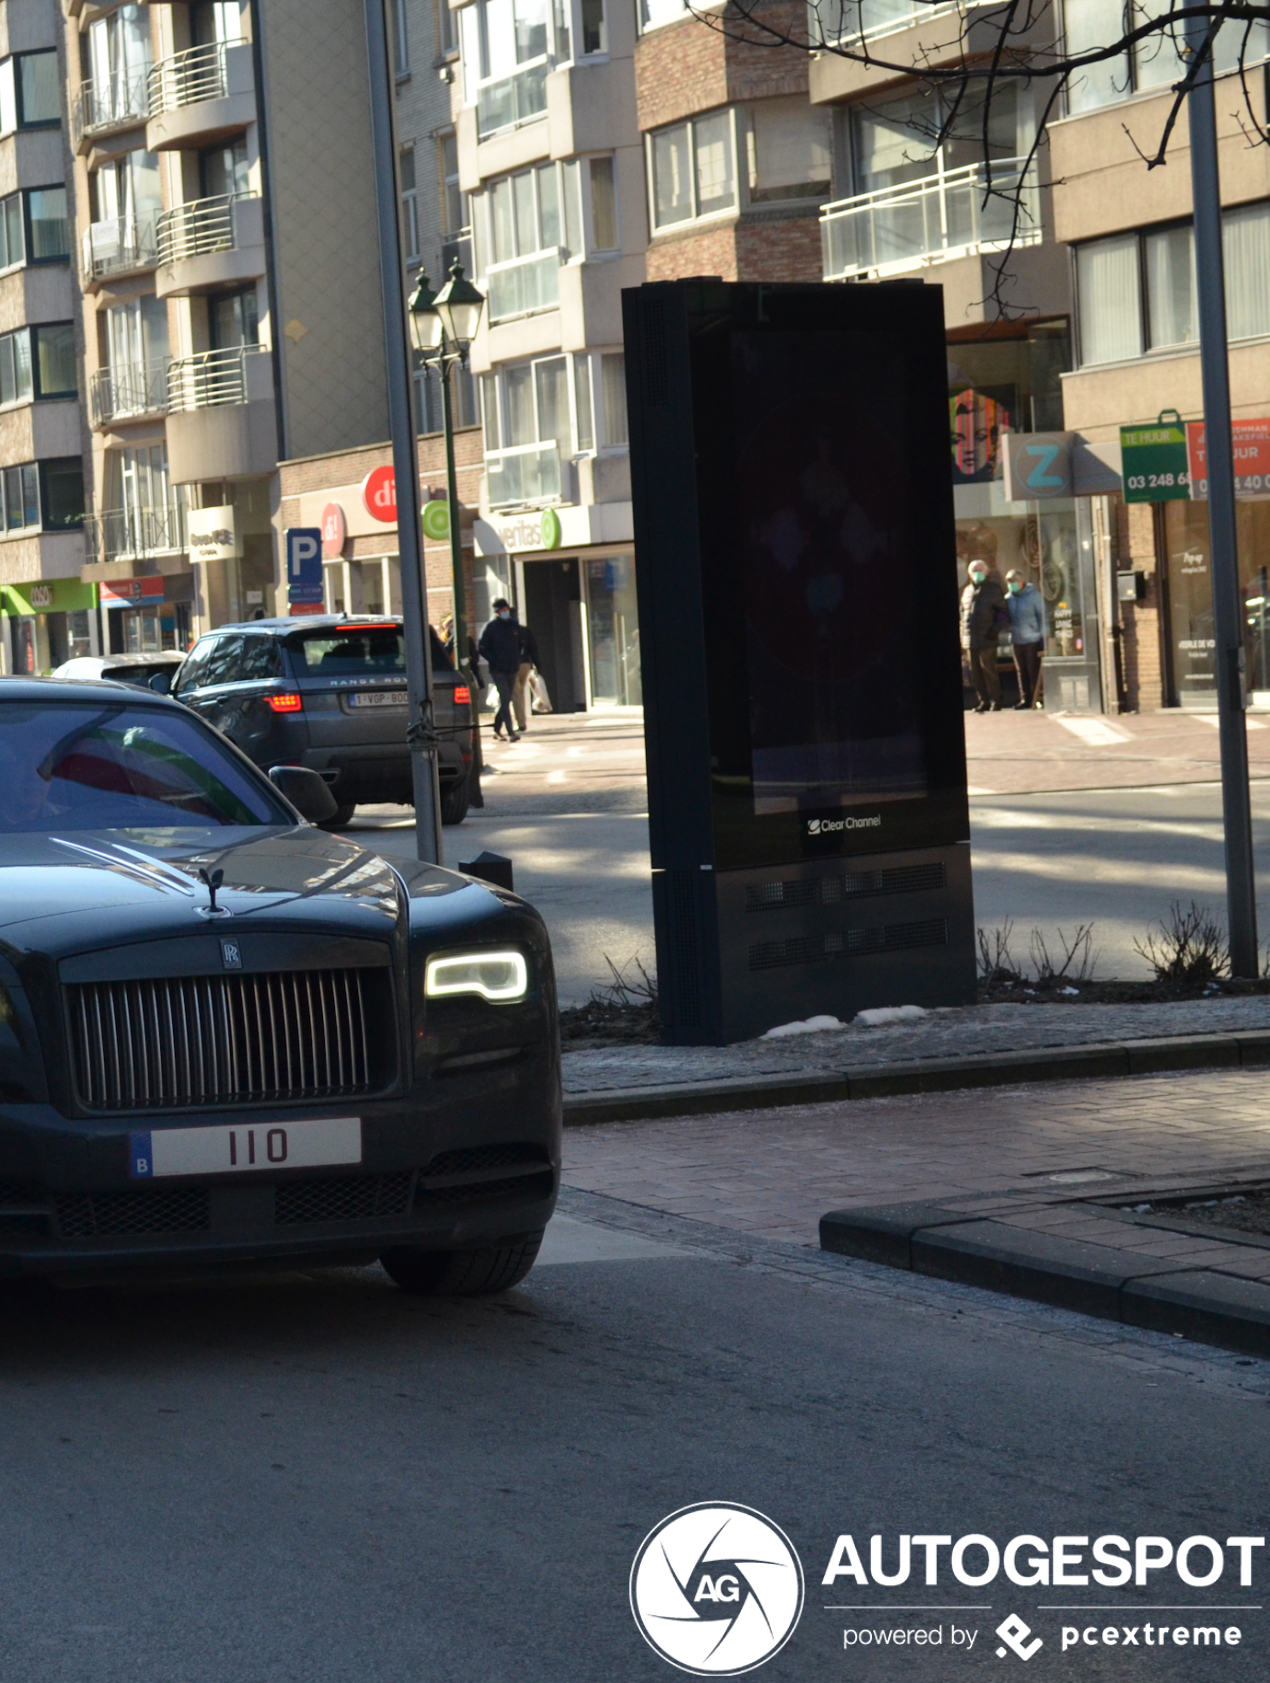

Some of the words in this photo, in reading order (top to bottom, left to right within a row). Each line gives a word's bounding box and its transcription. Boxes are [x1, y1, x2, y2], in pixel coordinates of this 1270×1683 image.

[1125, 433, 1137, 444] TE
[1139, 430, 1170, 442] HUUR
[1232, 425, 1268, 434] SHMAN
[1026, 445, 1064, 487] Z
[1127, 475, 1145, 489] 03
[1149, 473, 1174, 487] 248
[374, 479, 398, 507] di
[324, 514, 338, 541] di!
[499, 520, 542, 548] veritas
[292, 536, 318, 576] P
[821, 819, 845, 832] Clear
[845, 814, 881, 829] Channel
[136, 1158, 149, 1173] B
